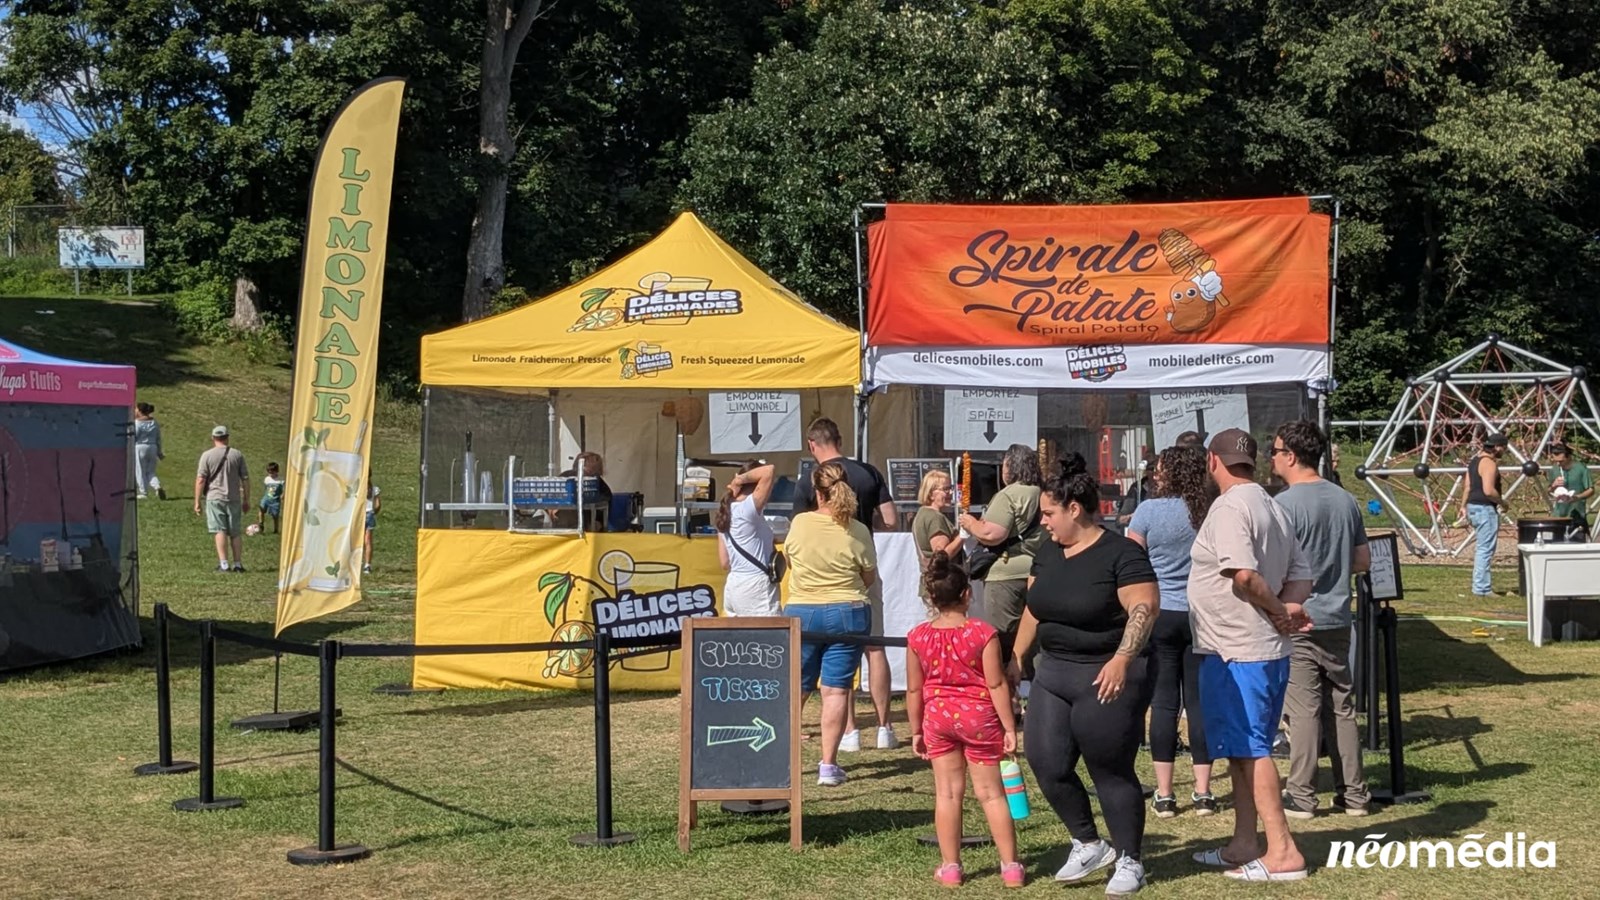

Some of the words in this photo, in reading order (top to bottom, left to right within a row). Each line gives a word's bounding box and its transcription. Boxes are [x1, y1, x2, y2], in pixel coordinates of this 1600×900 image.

[948, 229, 1159, 288] Spirale
[311, 147, 373, 425] LIMONADE
[1057, 273, 1091, 295] de
[629, 290, 738, 309] DÉLICES
[628, 300, 739, 317] LIMONADES
[628, 310, 692, 322] LEMONADE
[692, 307, 740, 317] DELITES
[963, 287, 1159, 333] Patate
[1030, 324, 1085, 336] Spiral
[1092, 323, 1160, 334] Potato
[472, 354, 517, 364] Limonade
[577, 355, 612, 364] Pressée
[681, 355, 707, 365] Fresh
[708, 355, 754, 366] Squeezed
[755, 355, 806, 364] Lemonade
[913, 351, 1044, 367] delicesmobiles.com
[1067, 344, 1123, 361] DÉLICES
[1148, 353, 1275, 367] mobiledelites.com
[1069, 353, 1126, 372] MOBILES
[29, 370, 62, 391] Fluffs
[726, 391, 782, 401] EMPORTEZ
[962, 388, 1019, 398] EMPORTEZ
[1161, 386, 1233, 400] COMMANDEZ
[728, 401, 780, 412] LIMONADE
[969, 410, 1011, 420] SPIRAL
[596, 588, 712, 625] DÉLICES
[599, 611, 714, 639] IMONA
[700, 640, 784, 669] BILLETS
[701, 677, 780, 702] TICKETS
